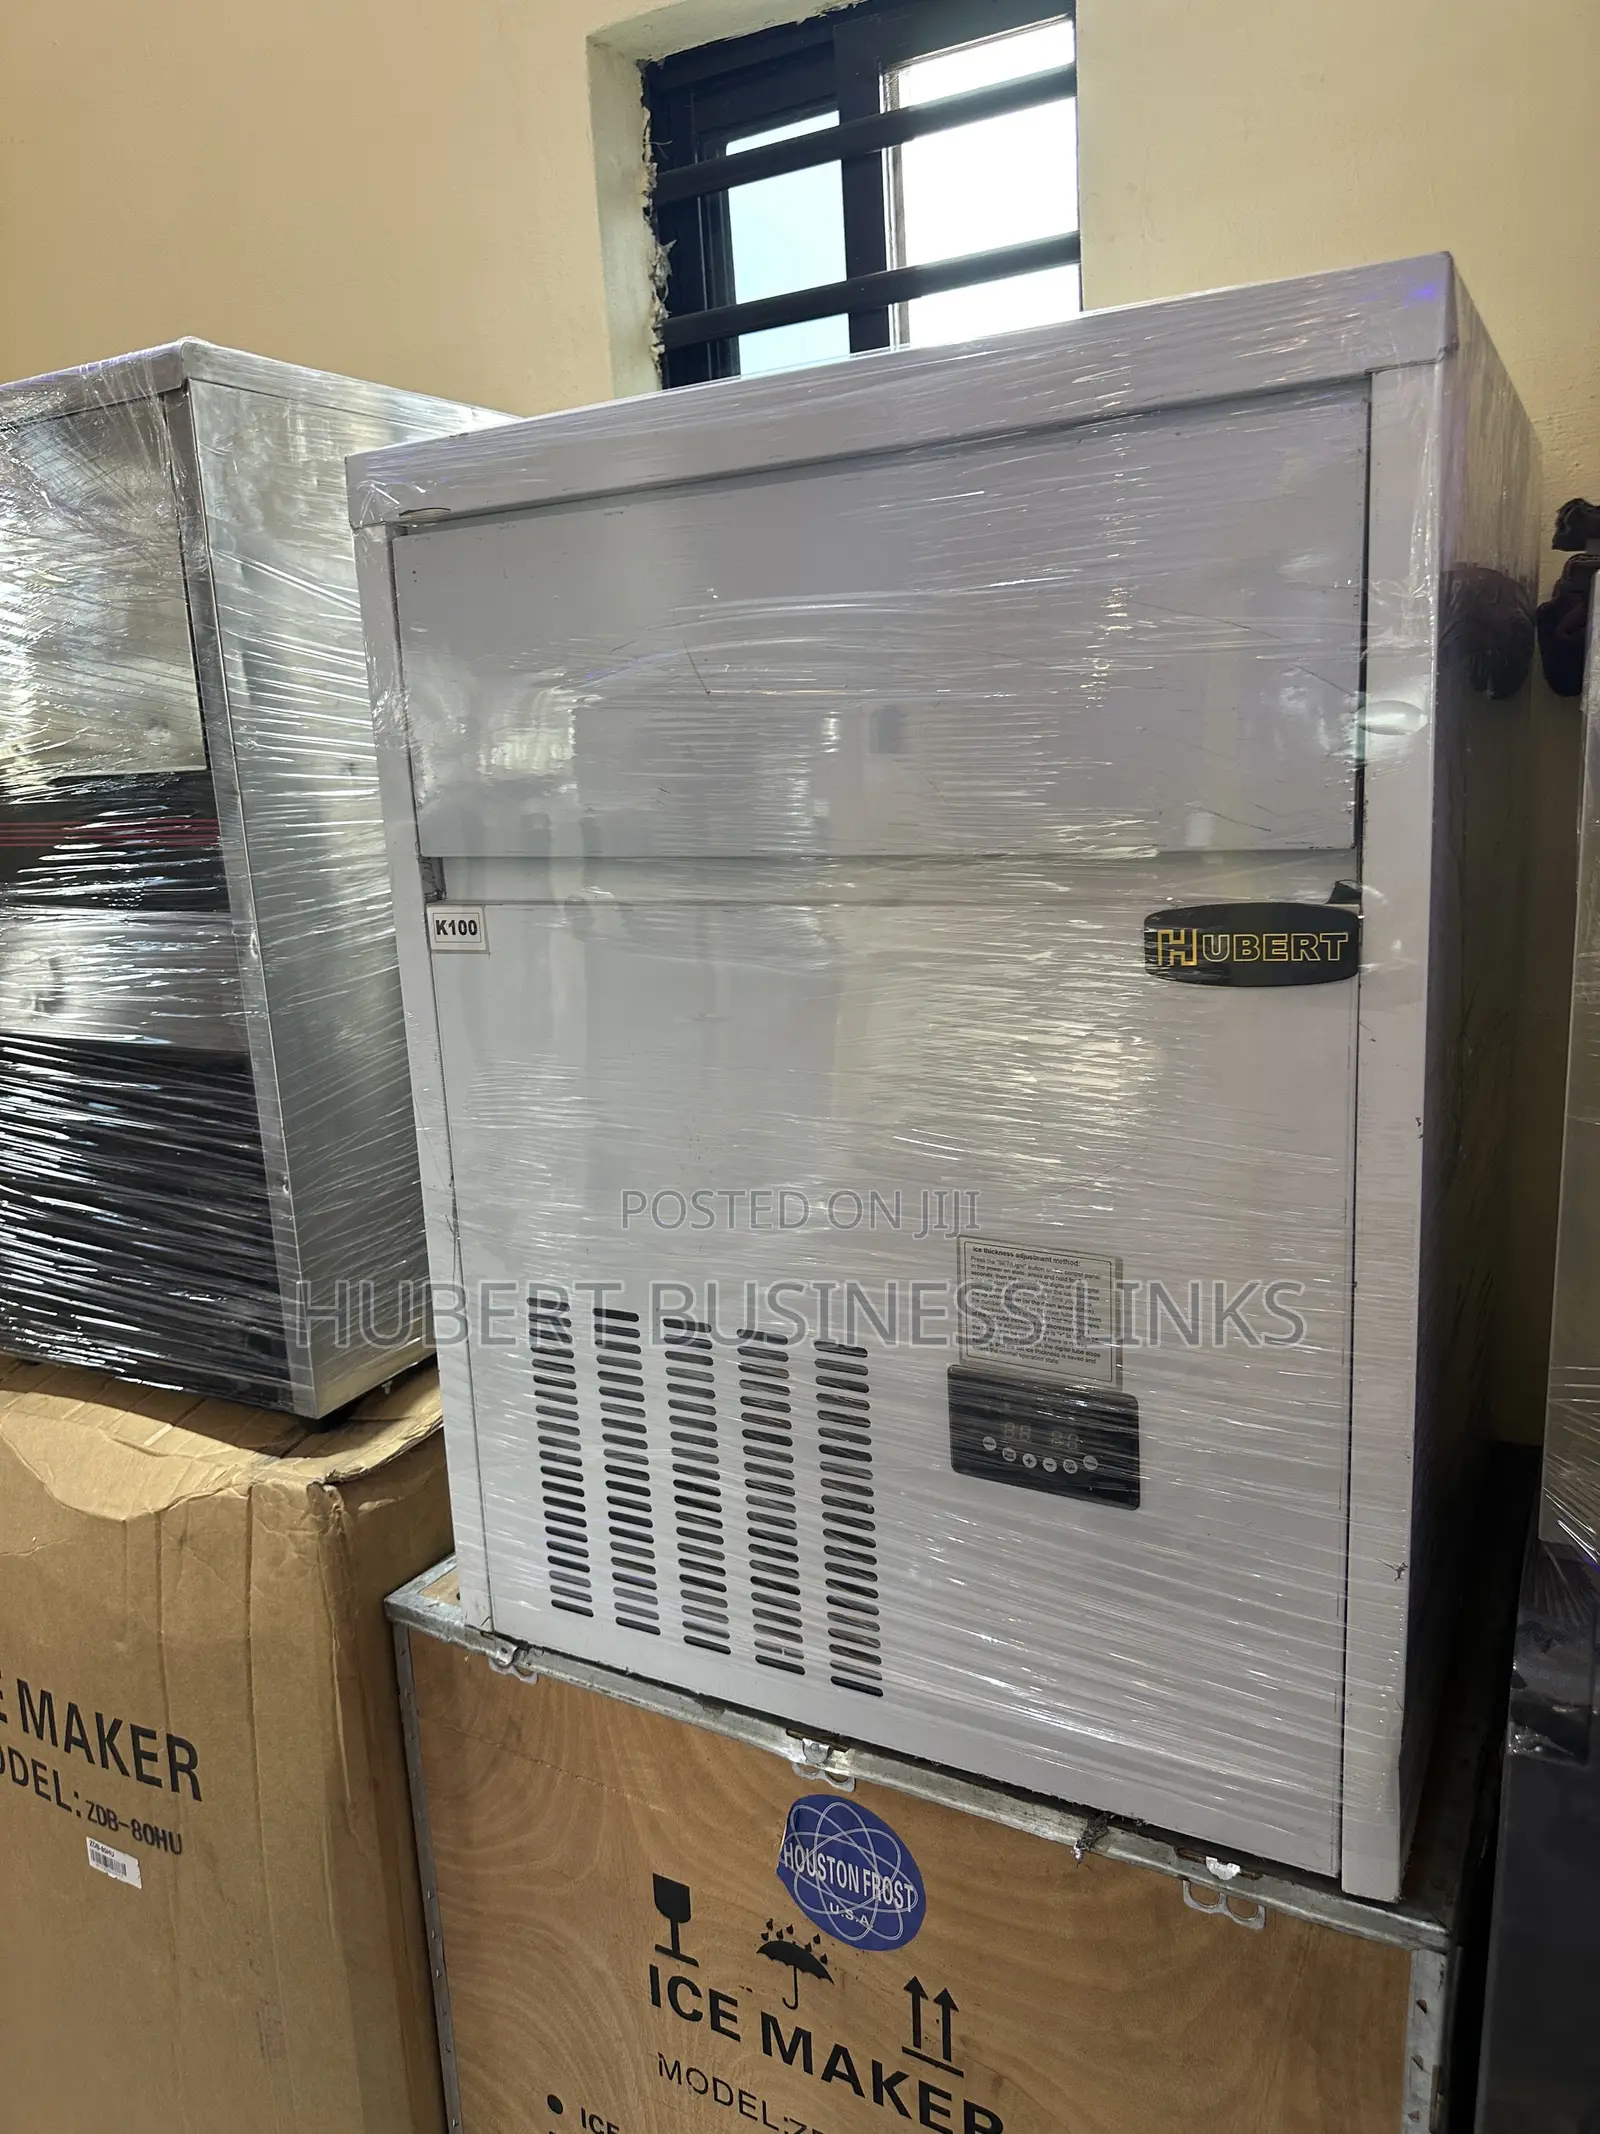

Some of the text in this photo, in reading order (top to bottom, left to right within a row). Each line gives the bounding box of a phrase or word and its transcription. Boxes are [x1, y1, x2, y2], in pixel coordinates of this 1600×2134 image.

[435, 919, 478, 936] K100
[1157, 928, 1348, 966] HUBERT
[983, 1247, 1014, 1257] thickness
[1014, 1252, 1052, 1264] adjustment
[17, 1677, 202, 1802] MAKER
[86, 1800, 182, 1855] ZDB-80HU
[783, 1842, 914, 1913] HOUSTON FROST
[649, 1964, 741, 2043] ICE
